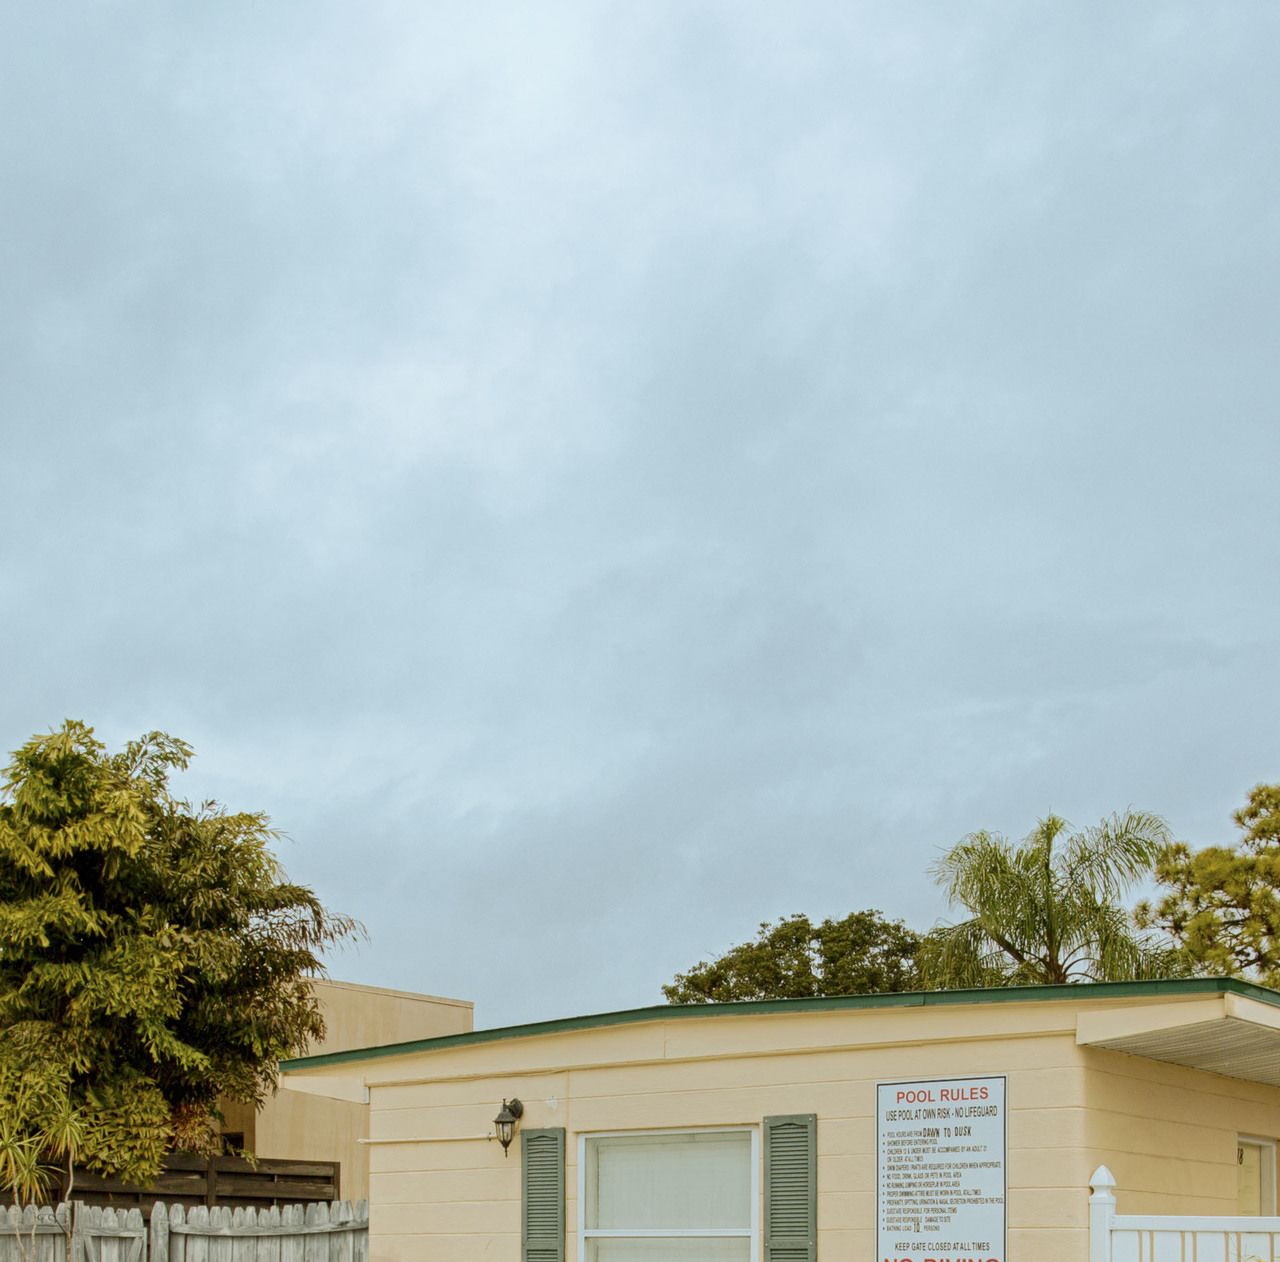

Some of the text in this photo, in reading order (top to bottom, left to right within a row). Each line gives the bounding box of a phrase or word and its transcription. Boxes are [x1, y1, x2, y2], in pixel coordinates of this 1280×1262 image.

[896, 1087, 989, 1104] POOL RULES
[886, 1110, 897, 1121] USE
[898, 1109, 913, 1121] POOL
[914, 1109, 922, 1120] AT
[922, 1108, 936, 1120] OWN
[937, 1107, 951, 1119] RISK
[955, 1107, 964, 1118] NO
[964, 1105, 998, 1118] LIFEGUARD
[922, 1127, 940, 1138] DAWN
[944, 1127, 952, 1138] TO
[954, 1126, 972, 1137] DUSK
[895, 1242, 910, 1251] KEEP
[912, 1242, 926, 1251] GATE
[927, 1242, 952, 1251] CLOSED
[972, 1242, 990, 1251] TIMES
